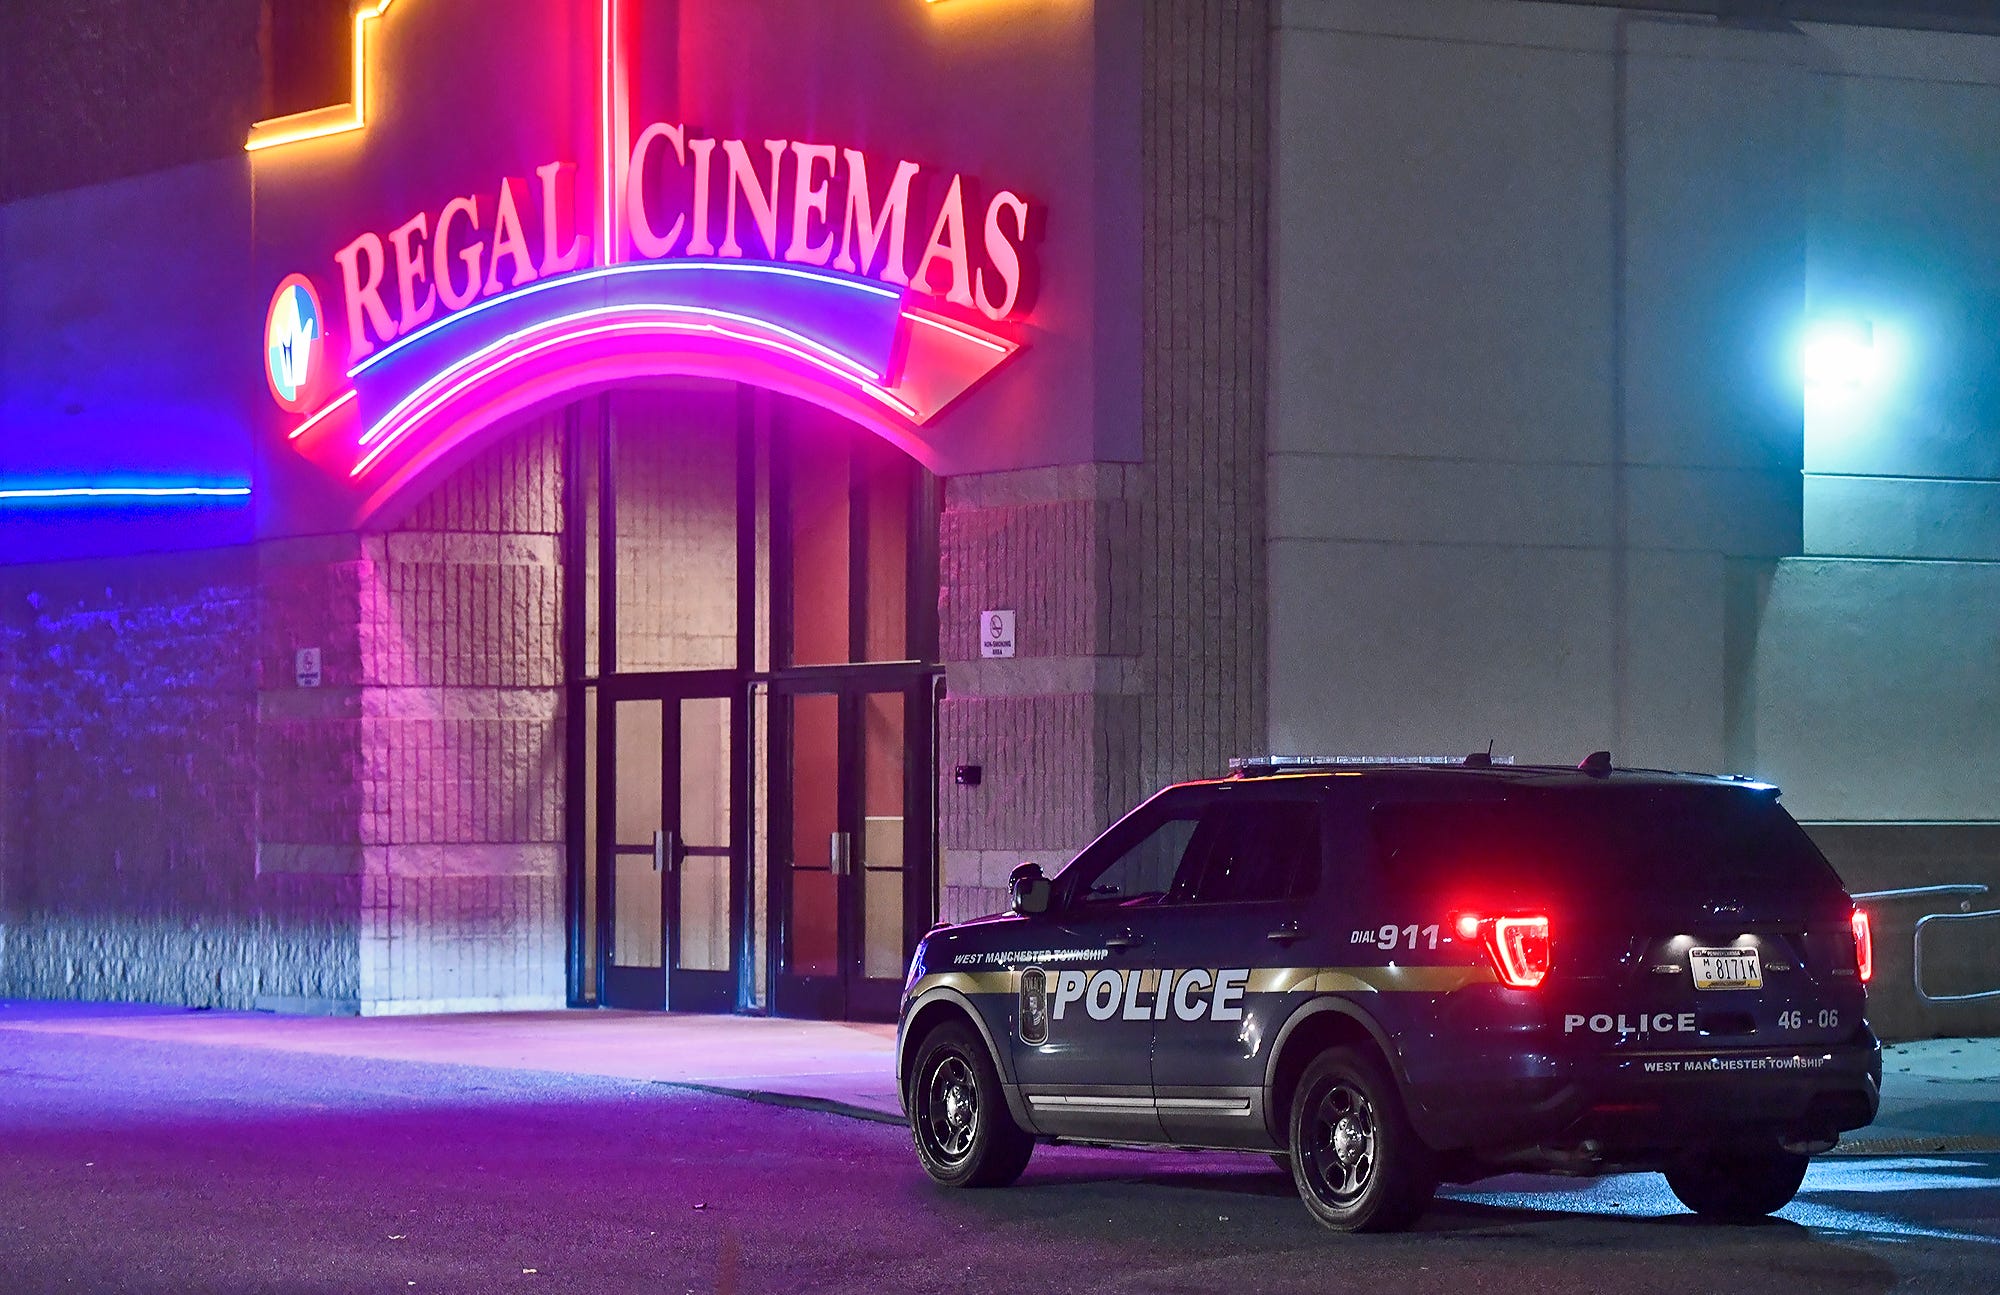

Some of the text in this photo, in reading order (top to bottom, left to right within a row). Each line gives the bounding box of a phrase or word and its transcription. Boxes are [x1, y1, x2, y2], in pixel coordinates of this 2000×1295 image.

[335, 122, 1028, 353] REGAL CINEMAS
[1350, 930, 1376, 944] DIAL
[953, 949, 1109, 964] WEST MANCHESTER TOWNSHIP
[1716, 959, 1757, 979] 8171K
[1052, 968, 1250, 1021] POLICE
[1564, 1013, 1696, 1033] POLICE
[1644, 1058, 1824, 1072] WEST MANCHESTER TOWNSHIP
